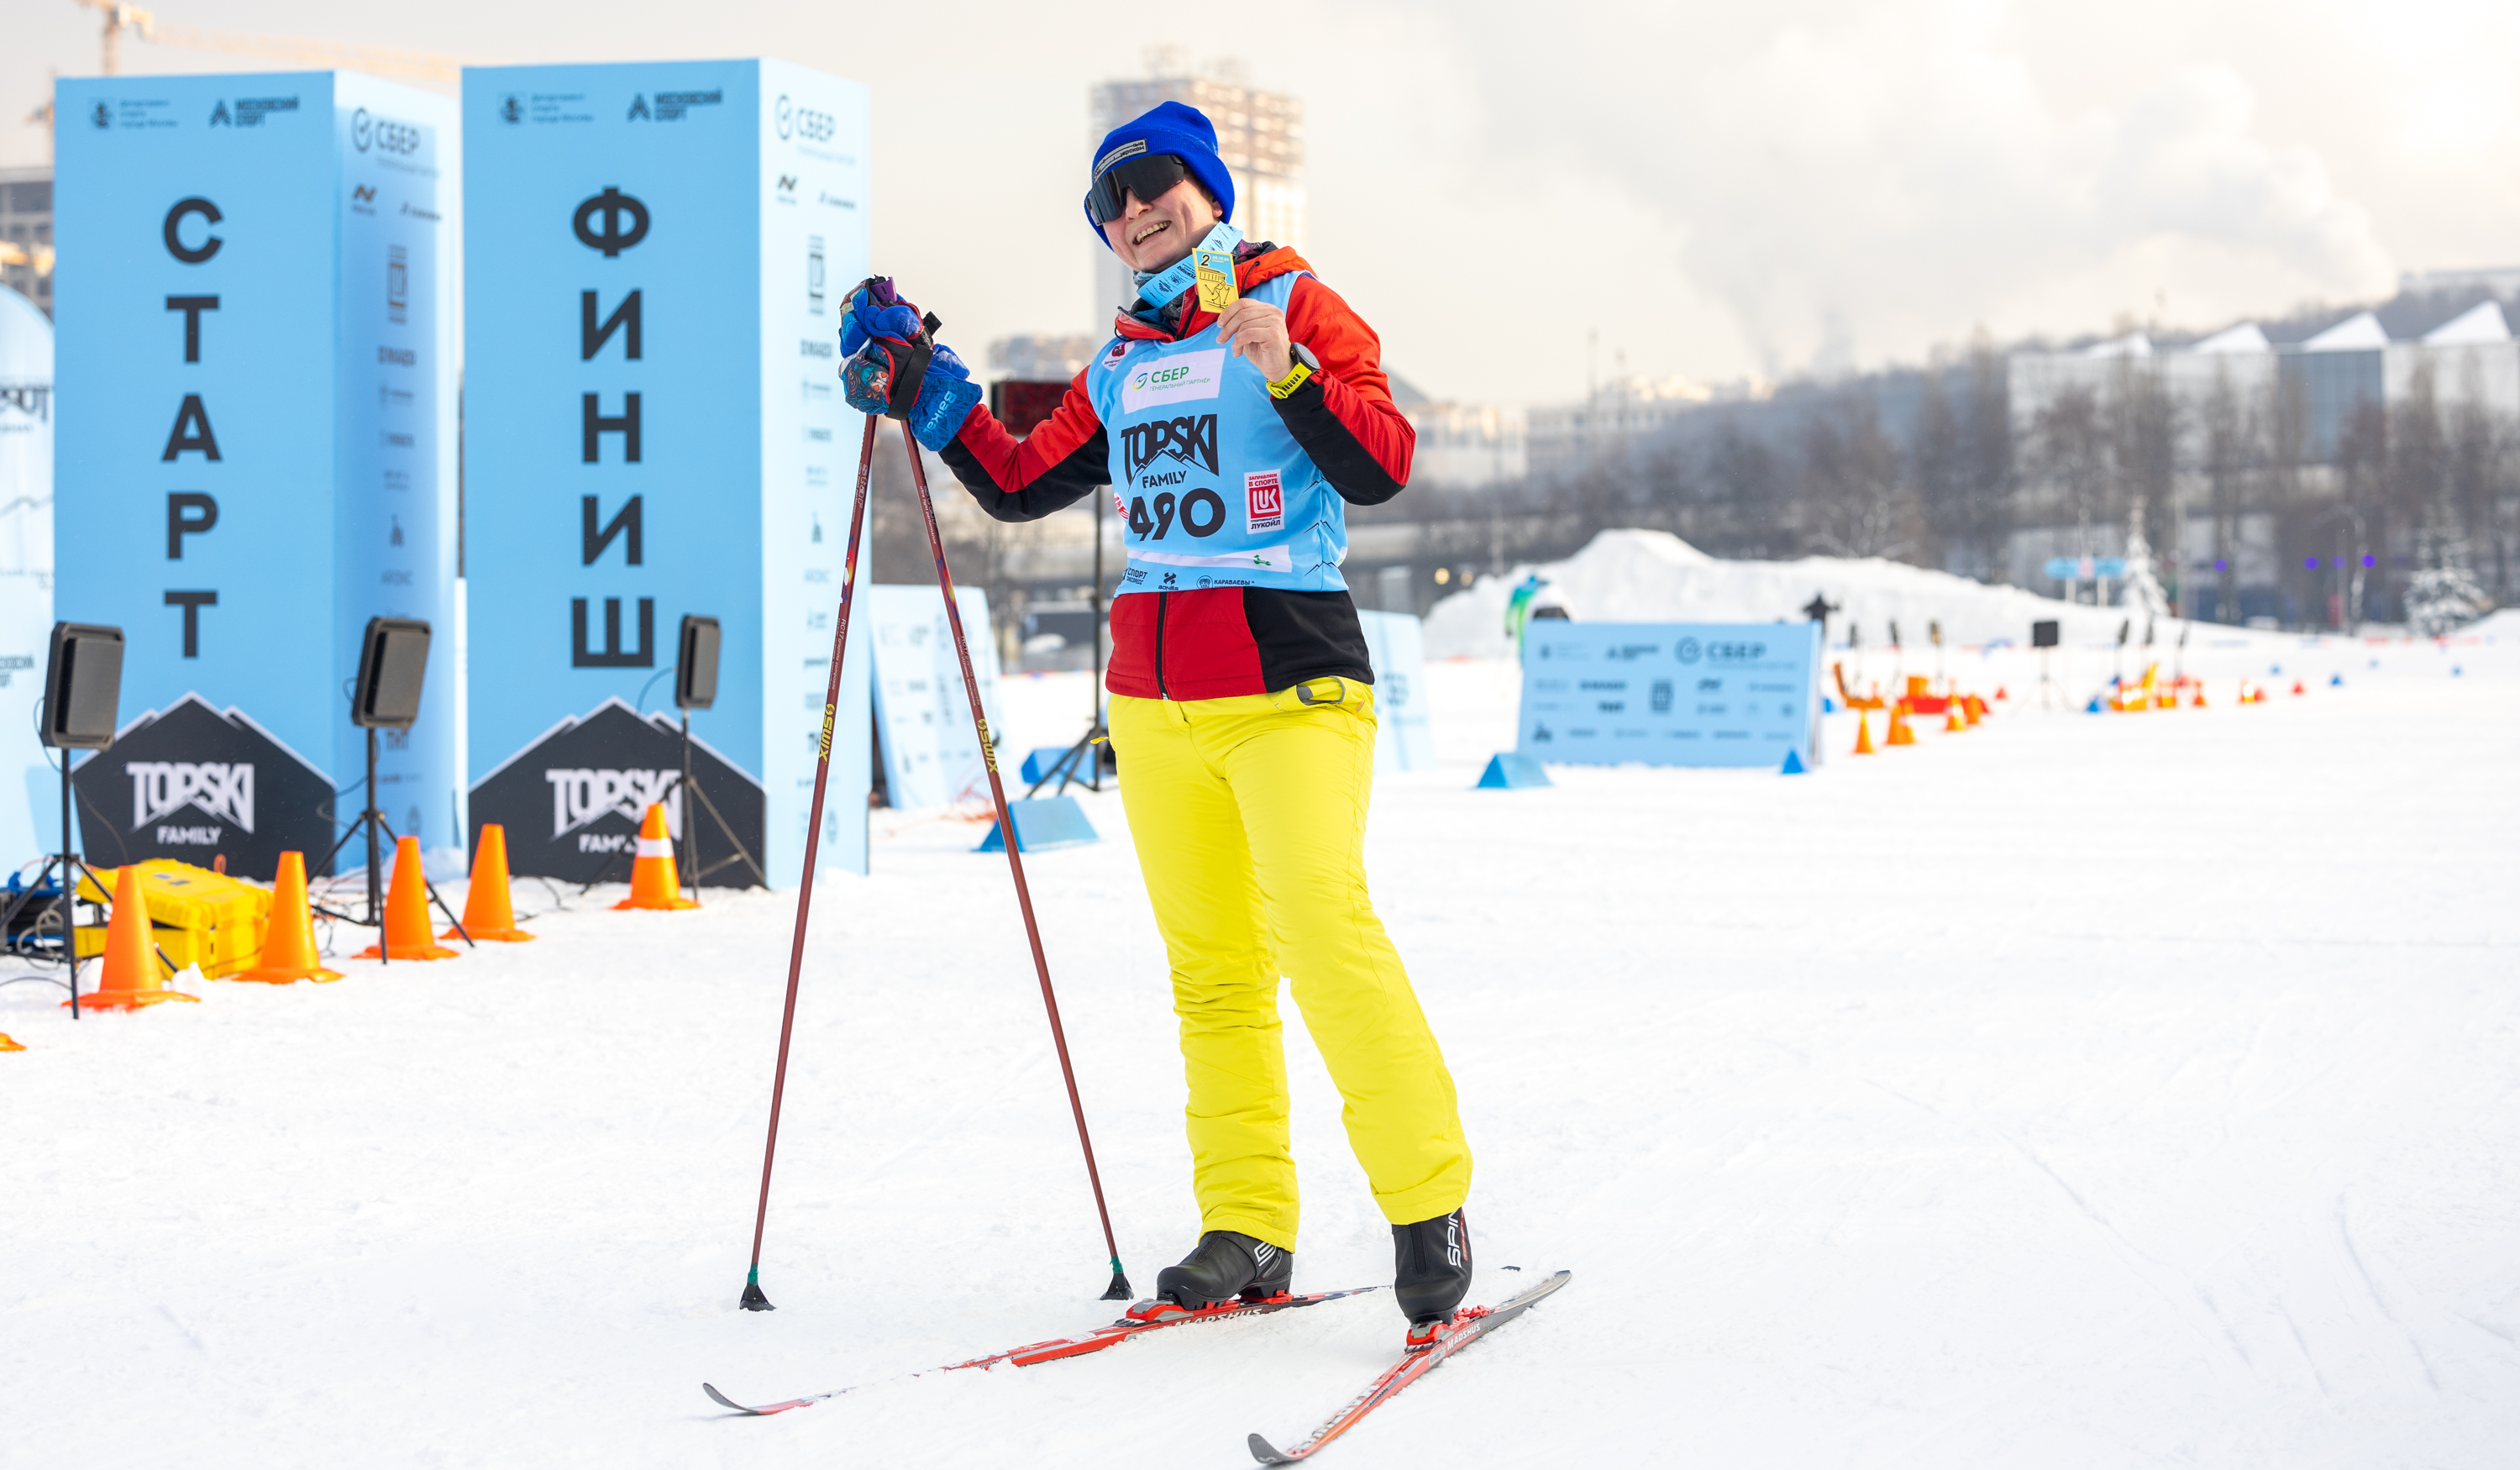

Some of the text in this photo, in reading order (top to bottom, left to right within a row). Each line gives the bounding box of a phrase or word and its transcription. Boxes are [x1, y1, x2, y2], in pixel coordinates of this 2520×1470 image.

[375, 119, 421, 155] СБЕР
[797, 107, 837, 143] СБЕР
[1201, 255, 1210, 266] 2
[1149, 377, 1210, 391] ГЕНЕРАЛЬНЫЙ ПАРТНЁР
[1151, 366, 1189, 383] СБЕР
[571, 186, 654, 668] ФИНИШ
[922, 391, 957, 433] Baikal
[161, 197, 223, 658] СТАРТ
[1121, 413, 1219, 491] TOPSKI
[1142, 470, 1187, 489] FAMILY
[1254, 478, 1278, 486] СПОРТЕ
[1128, 488, 1226, 542] 490
[1251, 519, 1280, 530] ЛУКОЙЛ
[1127, 567, 1147, 580] СПОРТ
[126, 761, 255, 835] TOPSKI
[157, 826, 222, 845] FAMILY
[1447, 1322, 1481, 1352] MADSHUS
